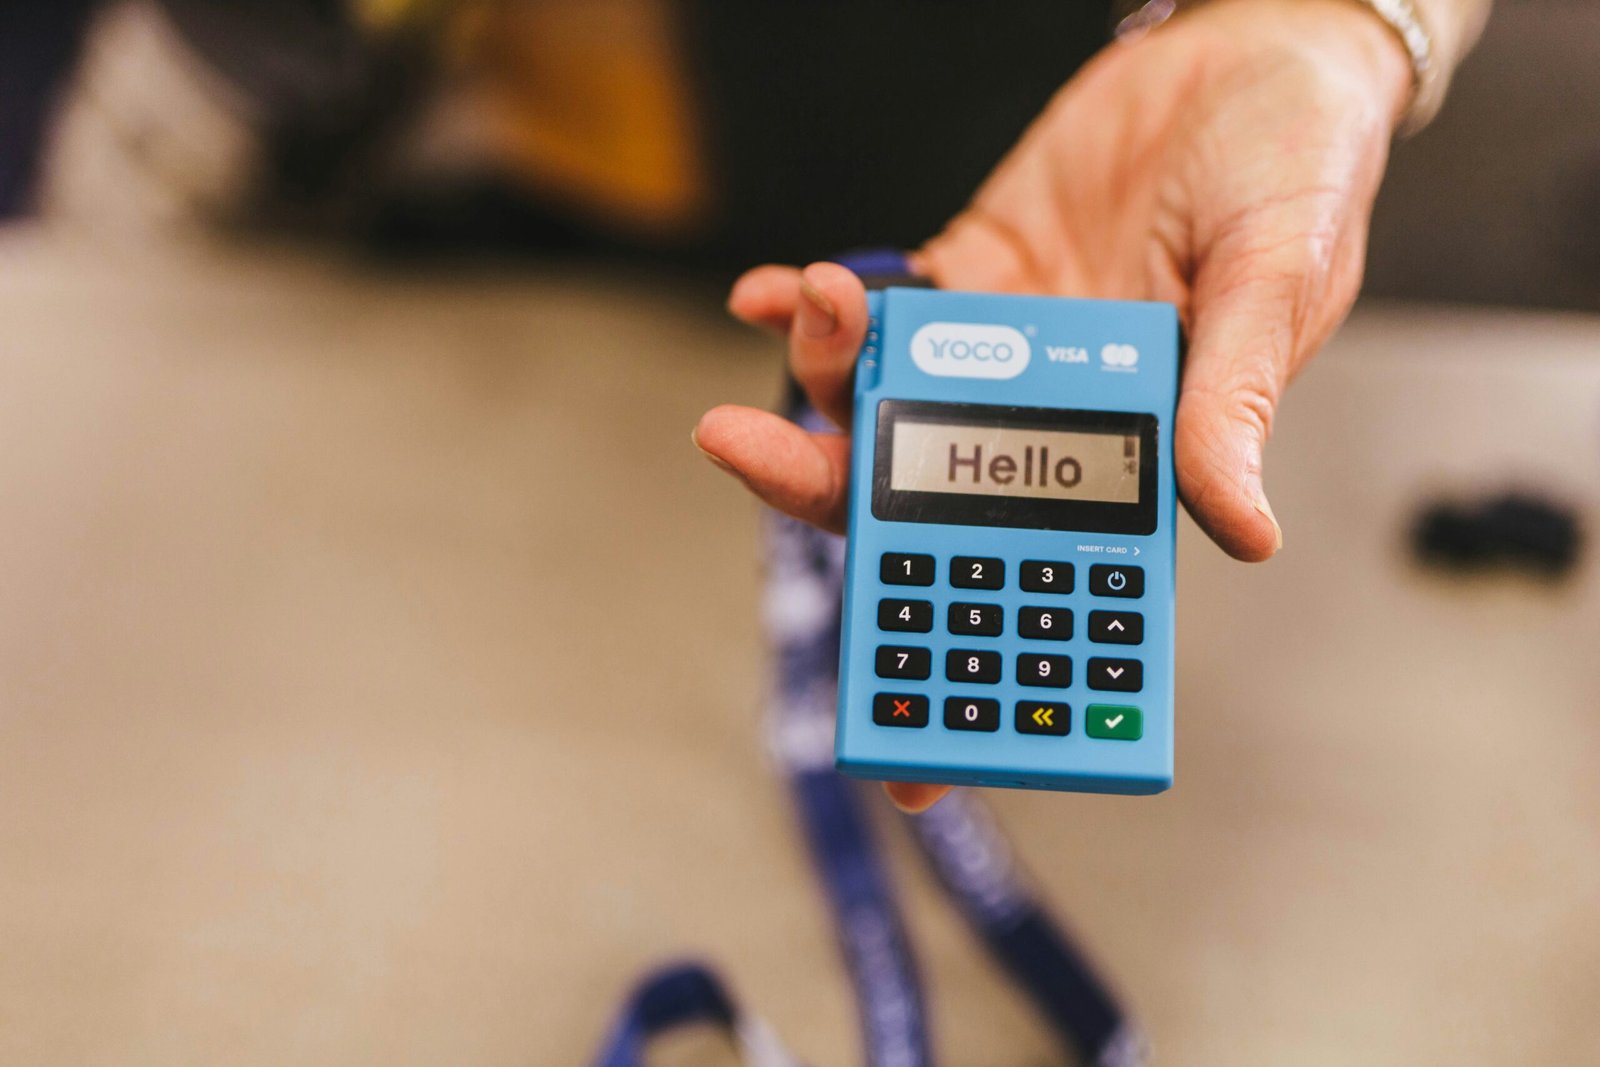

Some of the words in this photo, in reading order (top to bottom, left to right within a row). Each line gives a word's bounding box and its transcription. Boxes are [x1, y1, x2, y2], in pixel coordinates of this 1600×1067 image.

[928, 338, 1014, 364] YOCO
[1045, 345, 1089, 364] VISA
[948, 443, 1082, 489] Hello
[1077, 545, 1104, 553] INSERT
[1105, 546, 1128, 554] CARD
[902, 560, 912, 576] 1
[971, 563, 983, 579] 2
[1041, 567, 1054, 583] 3
[898, 606, 911, 622] 4
[969, 609, 982, 625] 5
[1040, 613, 1053, 629] 6
[896, 653, 909, 669] 7
[967, 656, 980, 673] 8
[1038, 660, 1051, 677] 9
[964, 704, 978, 721] 0
